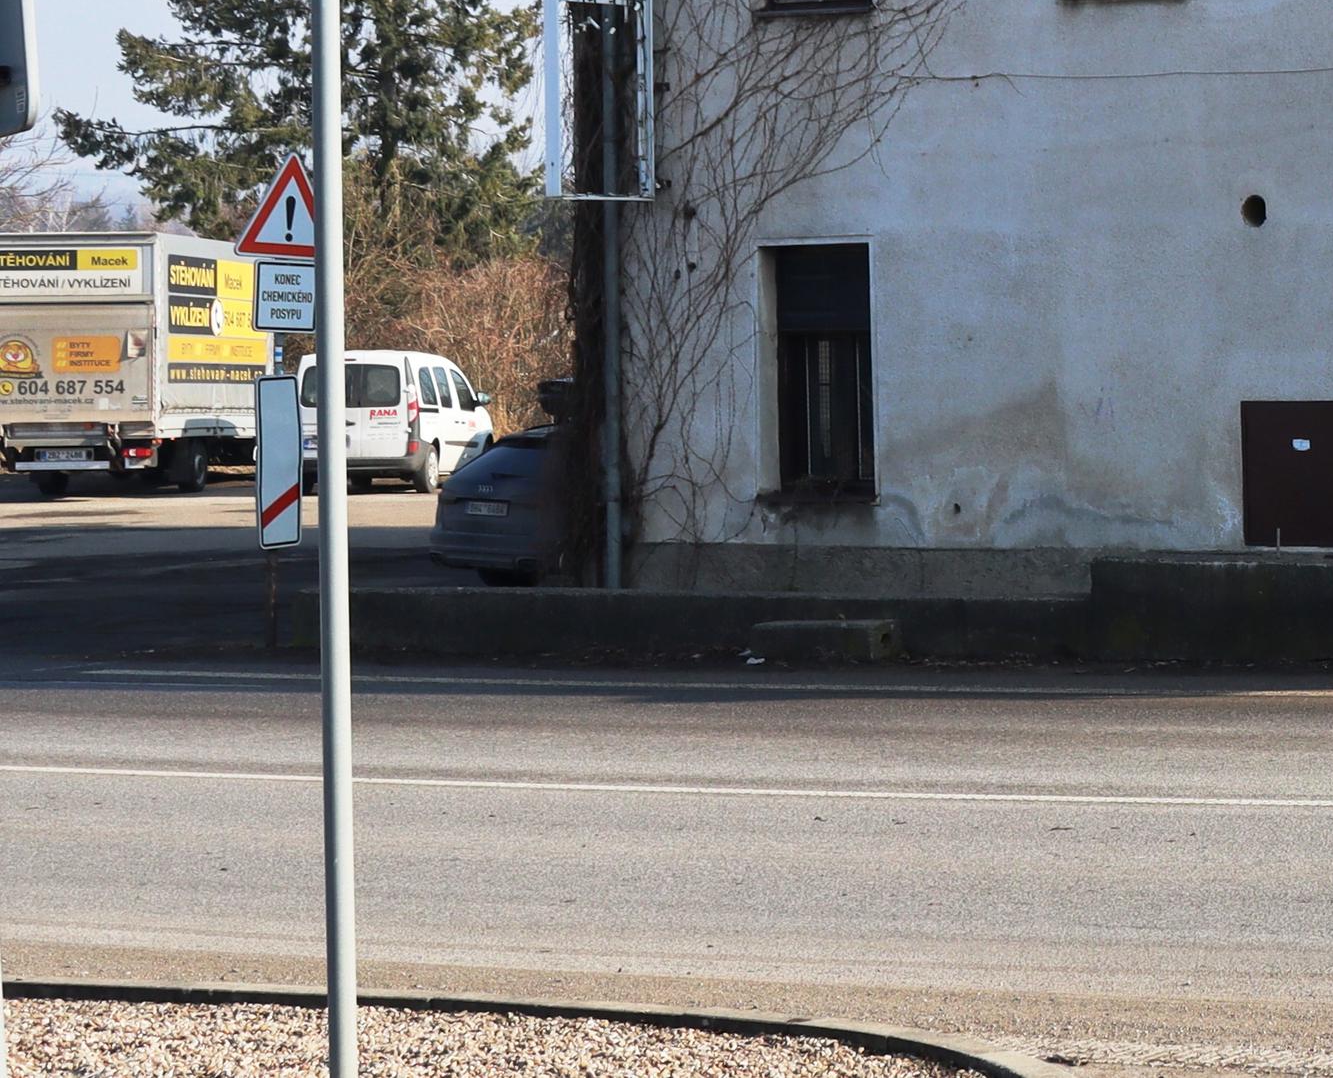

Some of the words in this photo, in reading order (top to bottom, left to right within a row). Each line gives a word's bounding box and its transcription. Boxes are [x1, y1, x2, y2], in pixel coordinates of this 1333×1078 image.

[91, 255, 128, 267] Macek
[170, 260, 215, 288] STĚHOVÁNÍ
[274, 273, 302, 286] KONEC
[67, 275, 131, 288] VYKLÍZENÍ
[261, 289, 313, 303] CHEMICKÉHO
[170, 302, 210, 327] VYKLÍZENÍ
[270, 308, 302, 320] POSYPU
[69, 341, 91, 349] BYTY
[69, 359, 111, 367] INSTITUCE
[17, 379, 49, 395] 604
[55, 379, 87, 395] 687
[93, 379, 126, 395] 554
[369, 409, 398, 421] RANA
